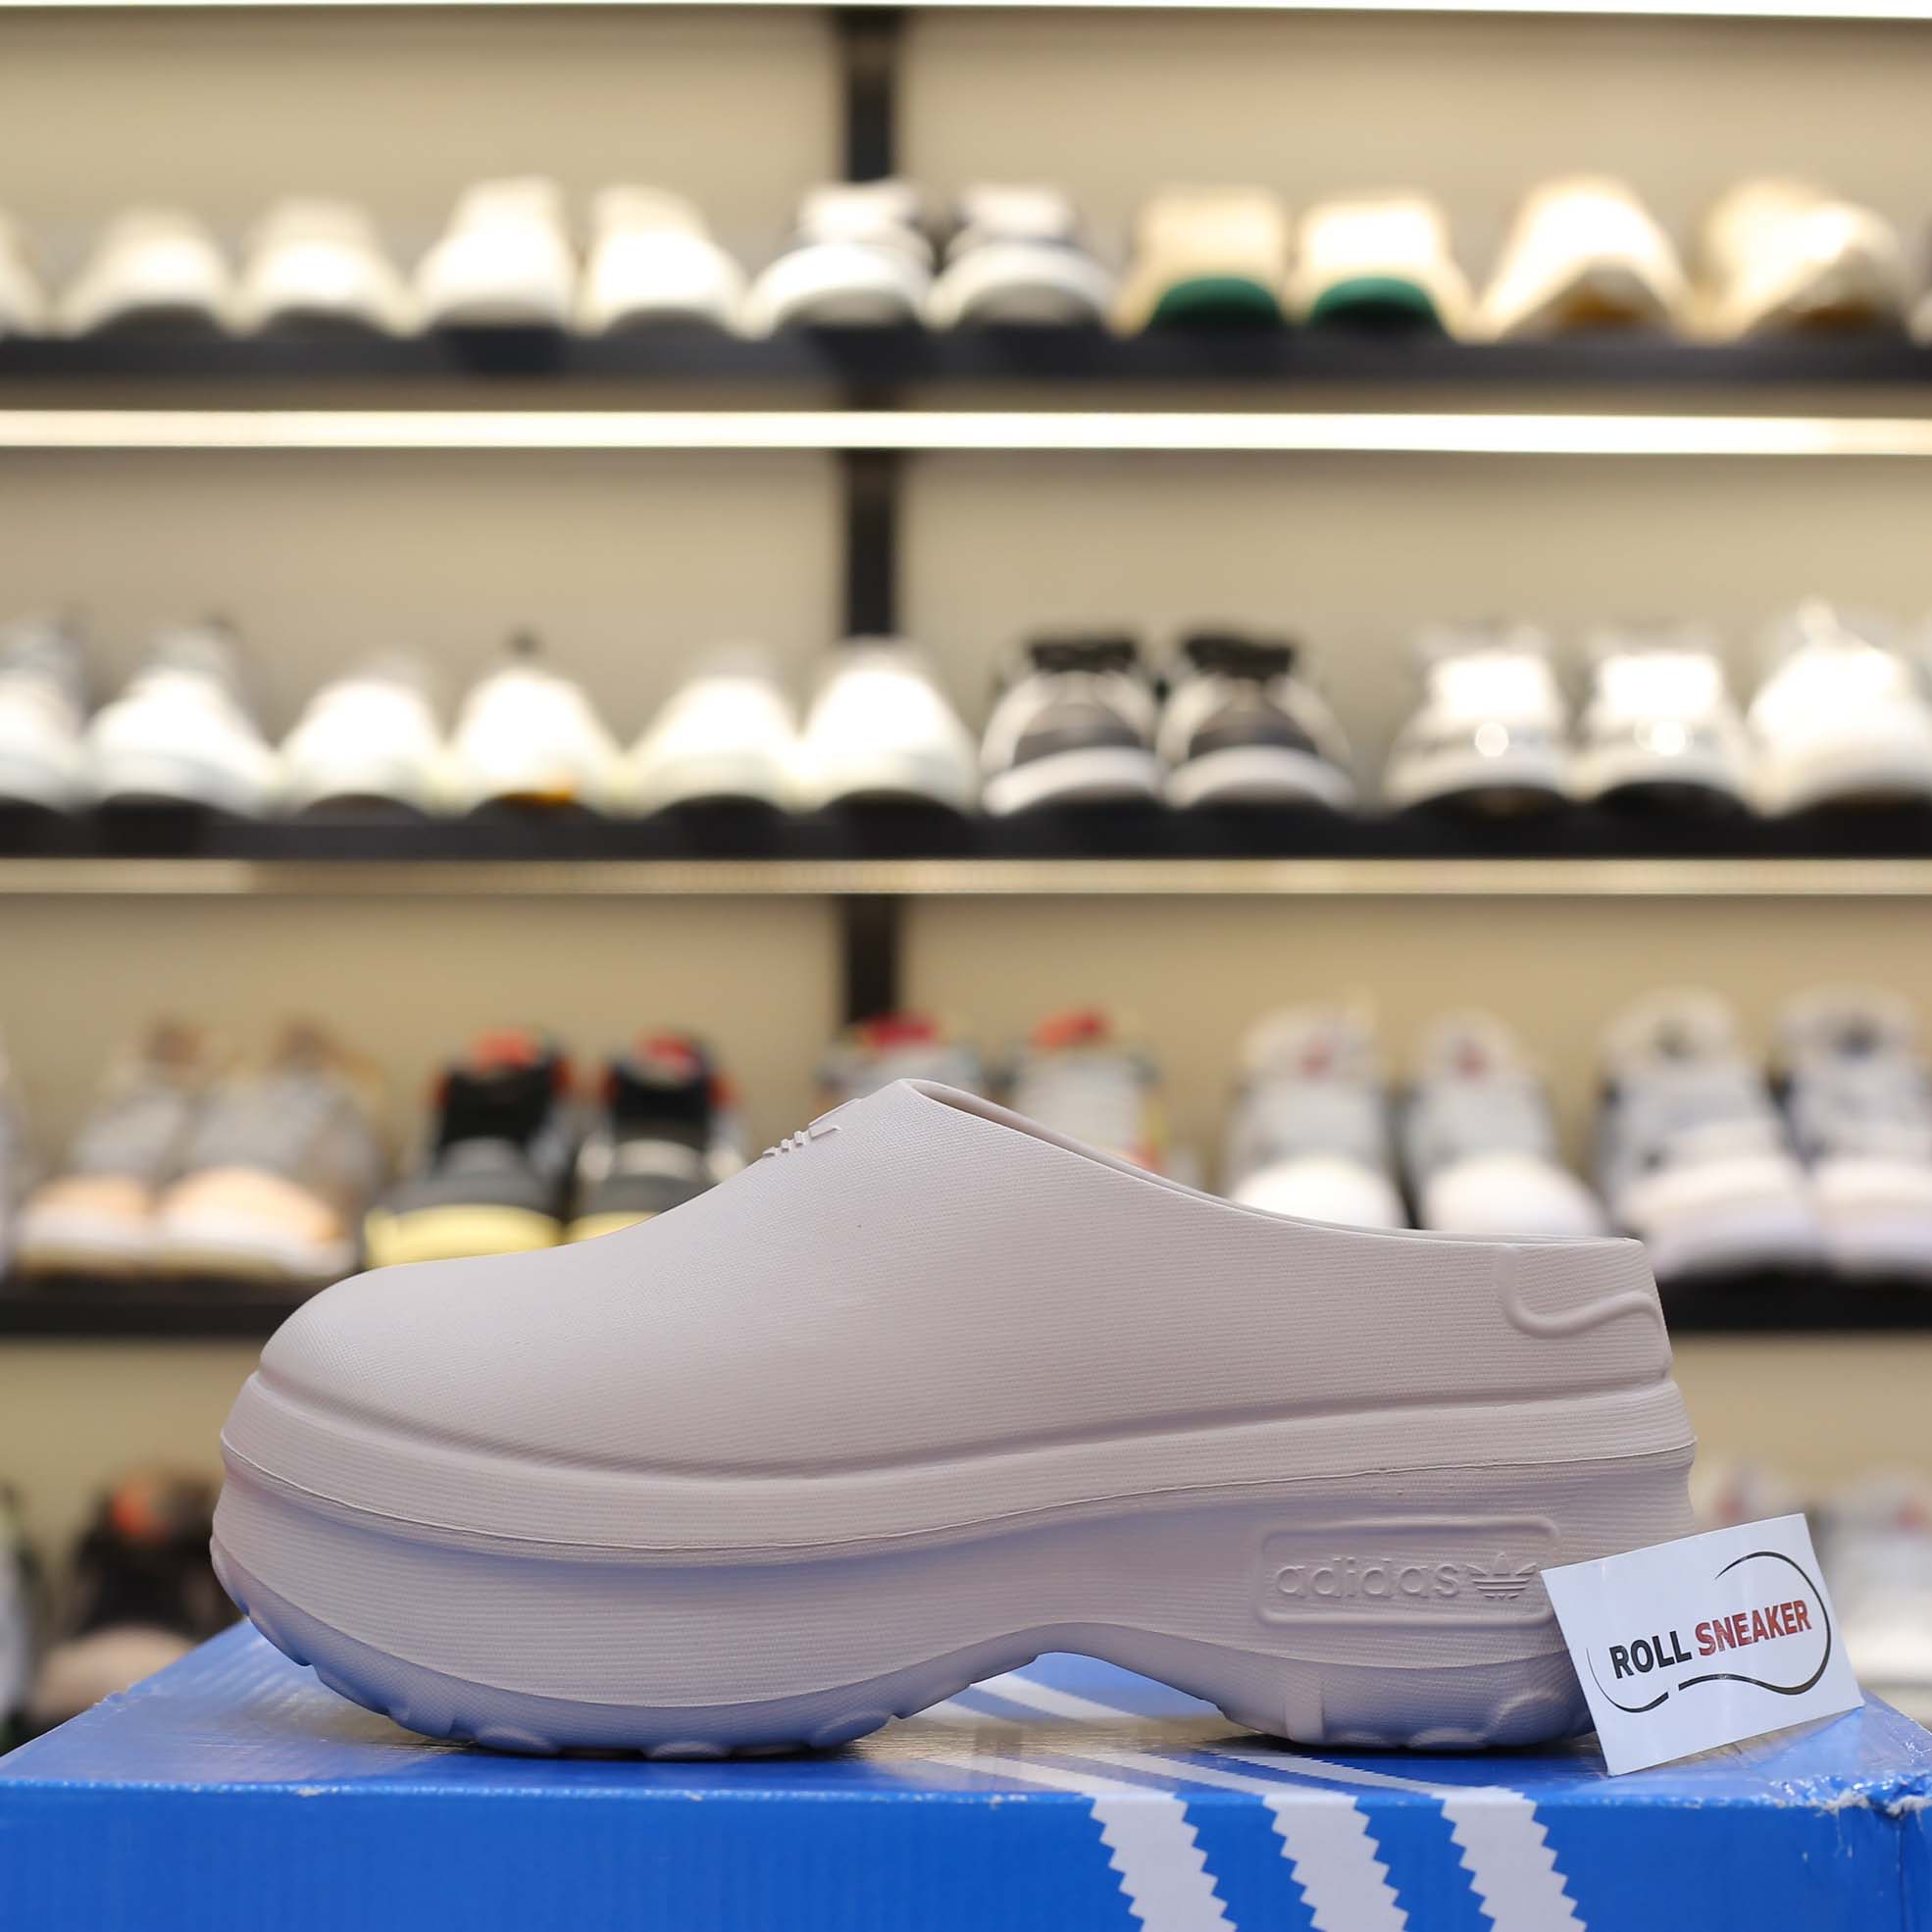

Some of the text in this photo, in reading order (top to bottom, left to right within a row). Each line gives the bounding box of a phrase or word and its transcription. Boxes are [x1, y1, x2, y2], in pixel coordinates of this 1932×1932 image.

[1277, 1556, 1459, 1598] adidas
[1609, 1600, 1812, 1679] ROLL SNEAKER
